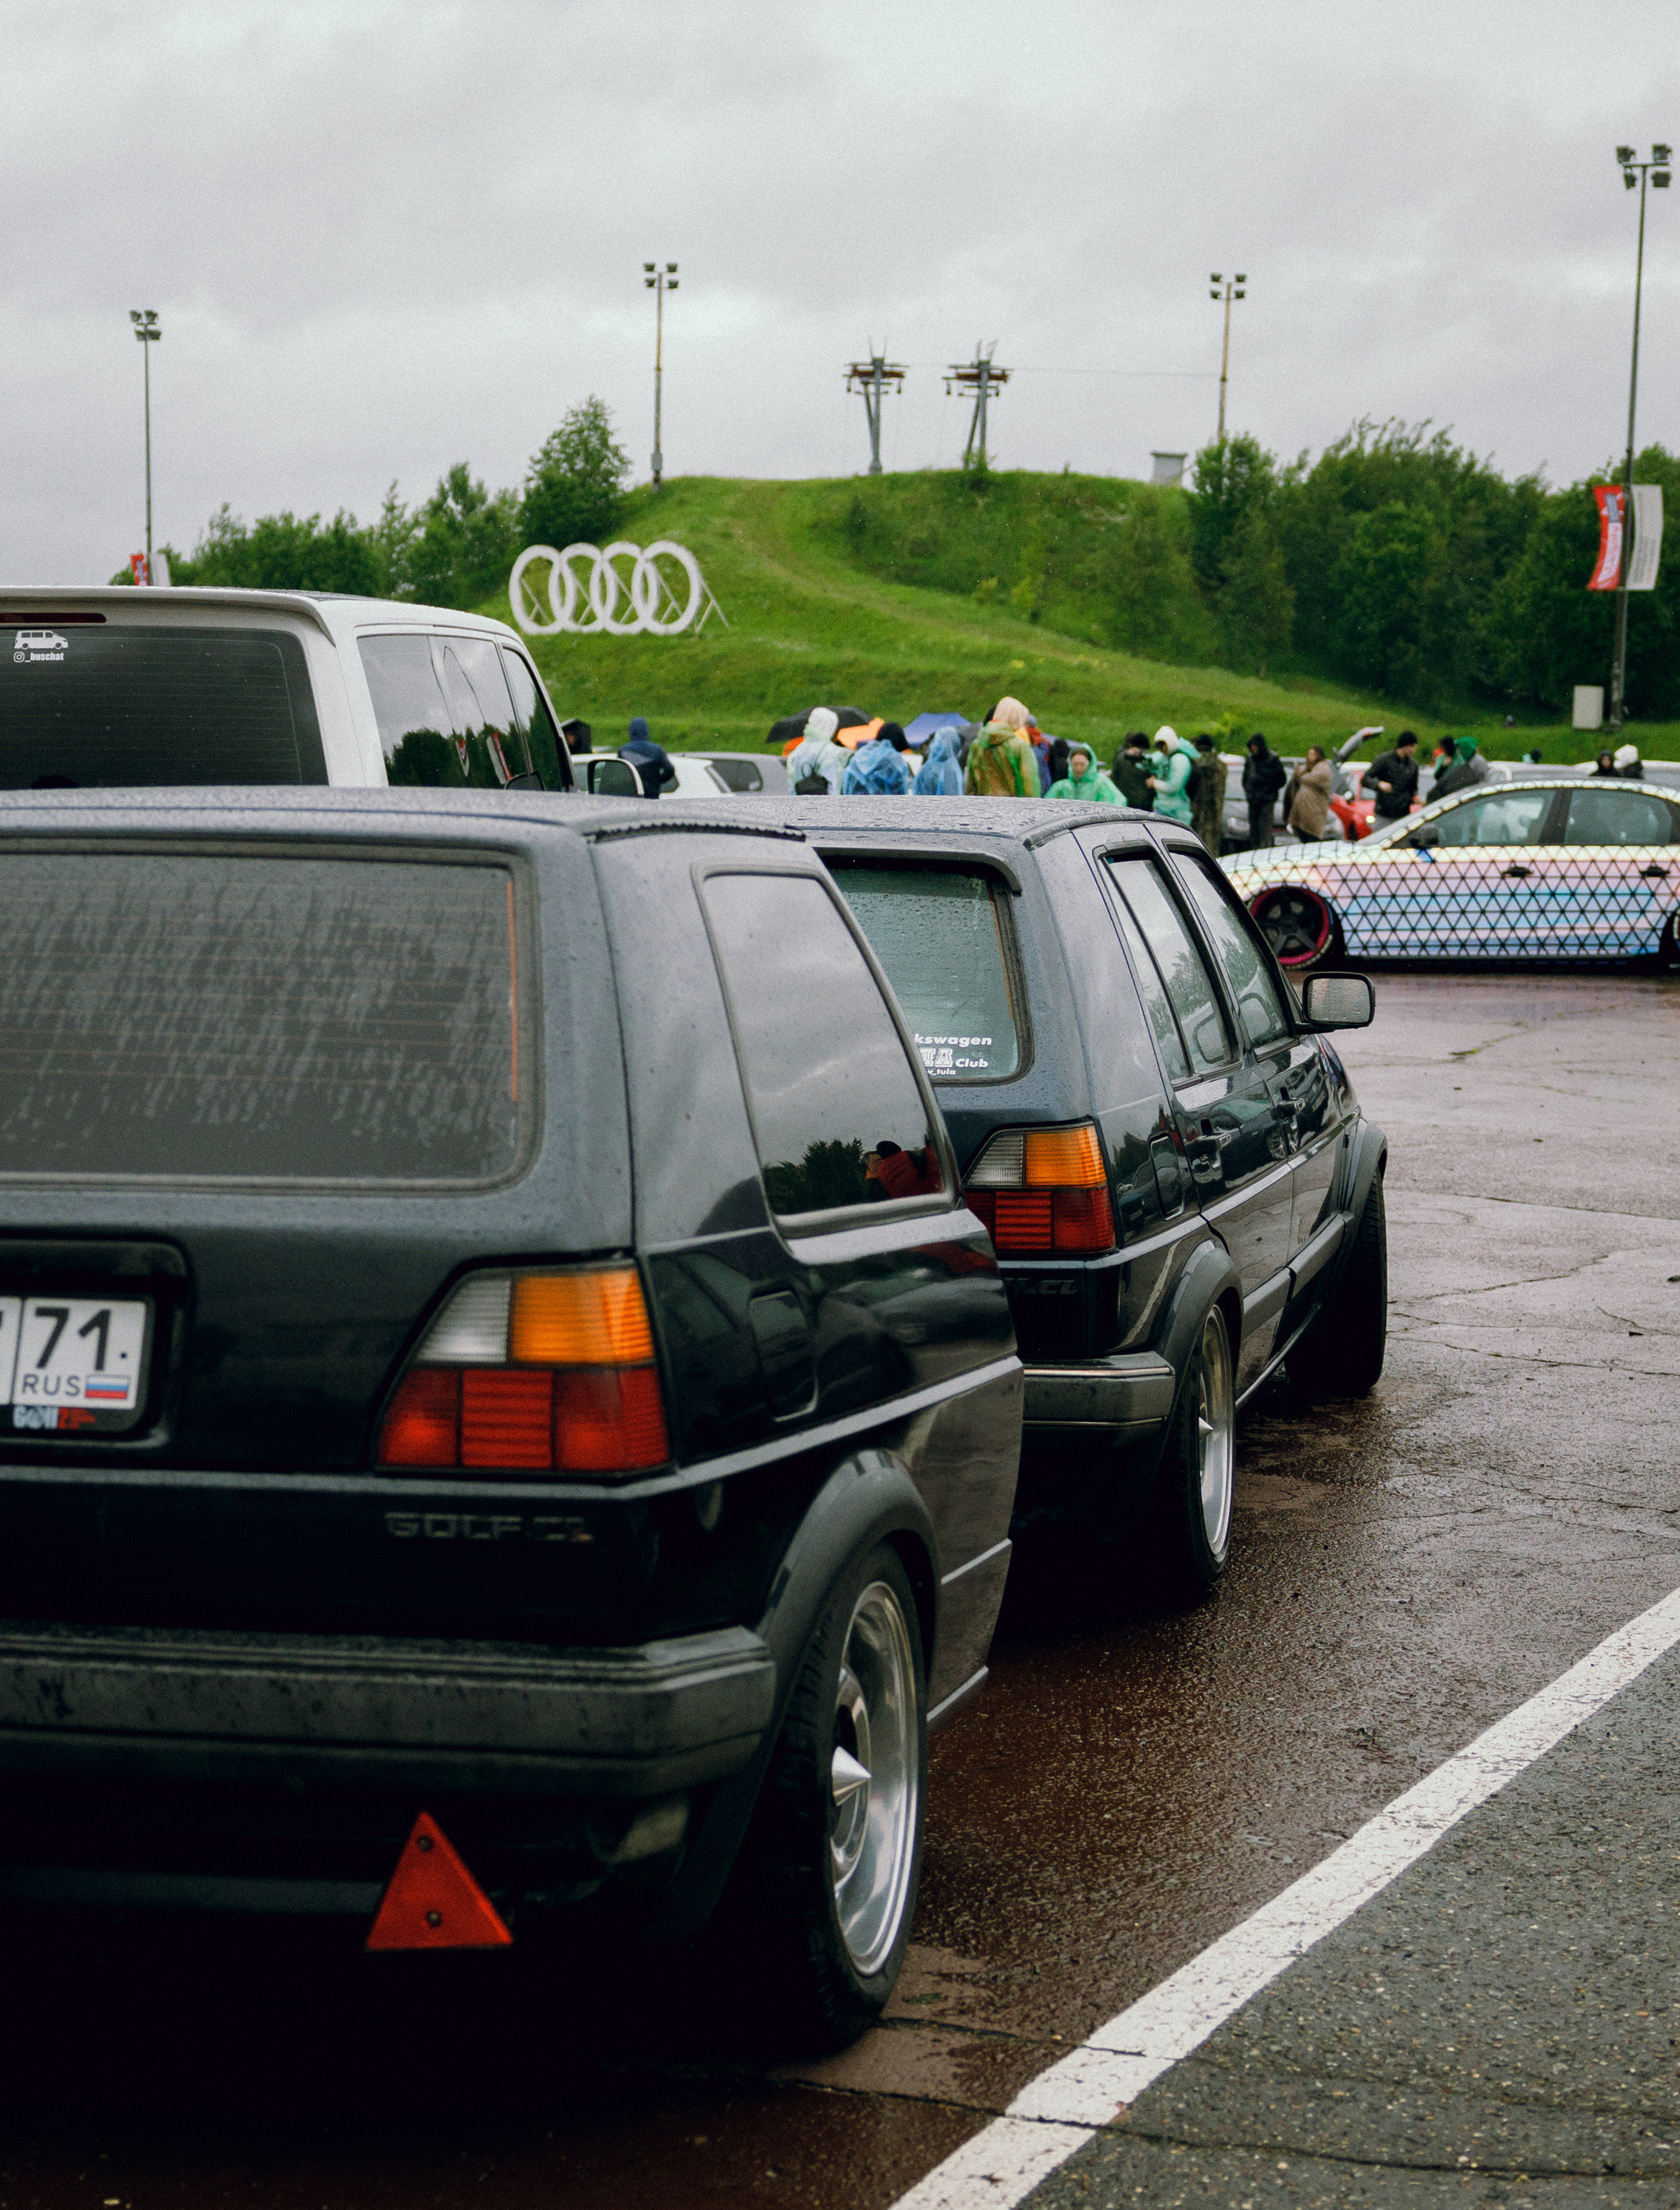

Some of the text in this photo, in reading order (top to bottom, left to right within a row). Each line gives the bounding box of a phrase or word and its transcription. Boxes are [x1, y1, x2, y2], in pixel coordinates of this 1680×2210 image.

[914, 1033, 992, 1047] kswagen
[956, 1058, 989, 1068] Club
[22, 1373, 81, 1397] RUS
